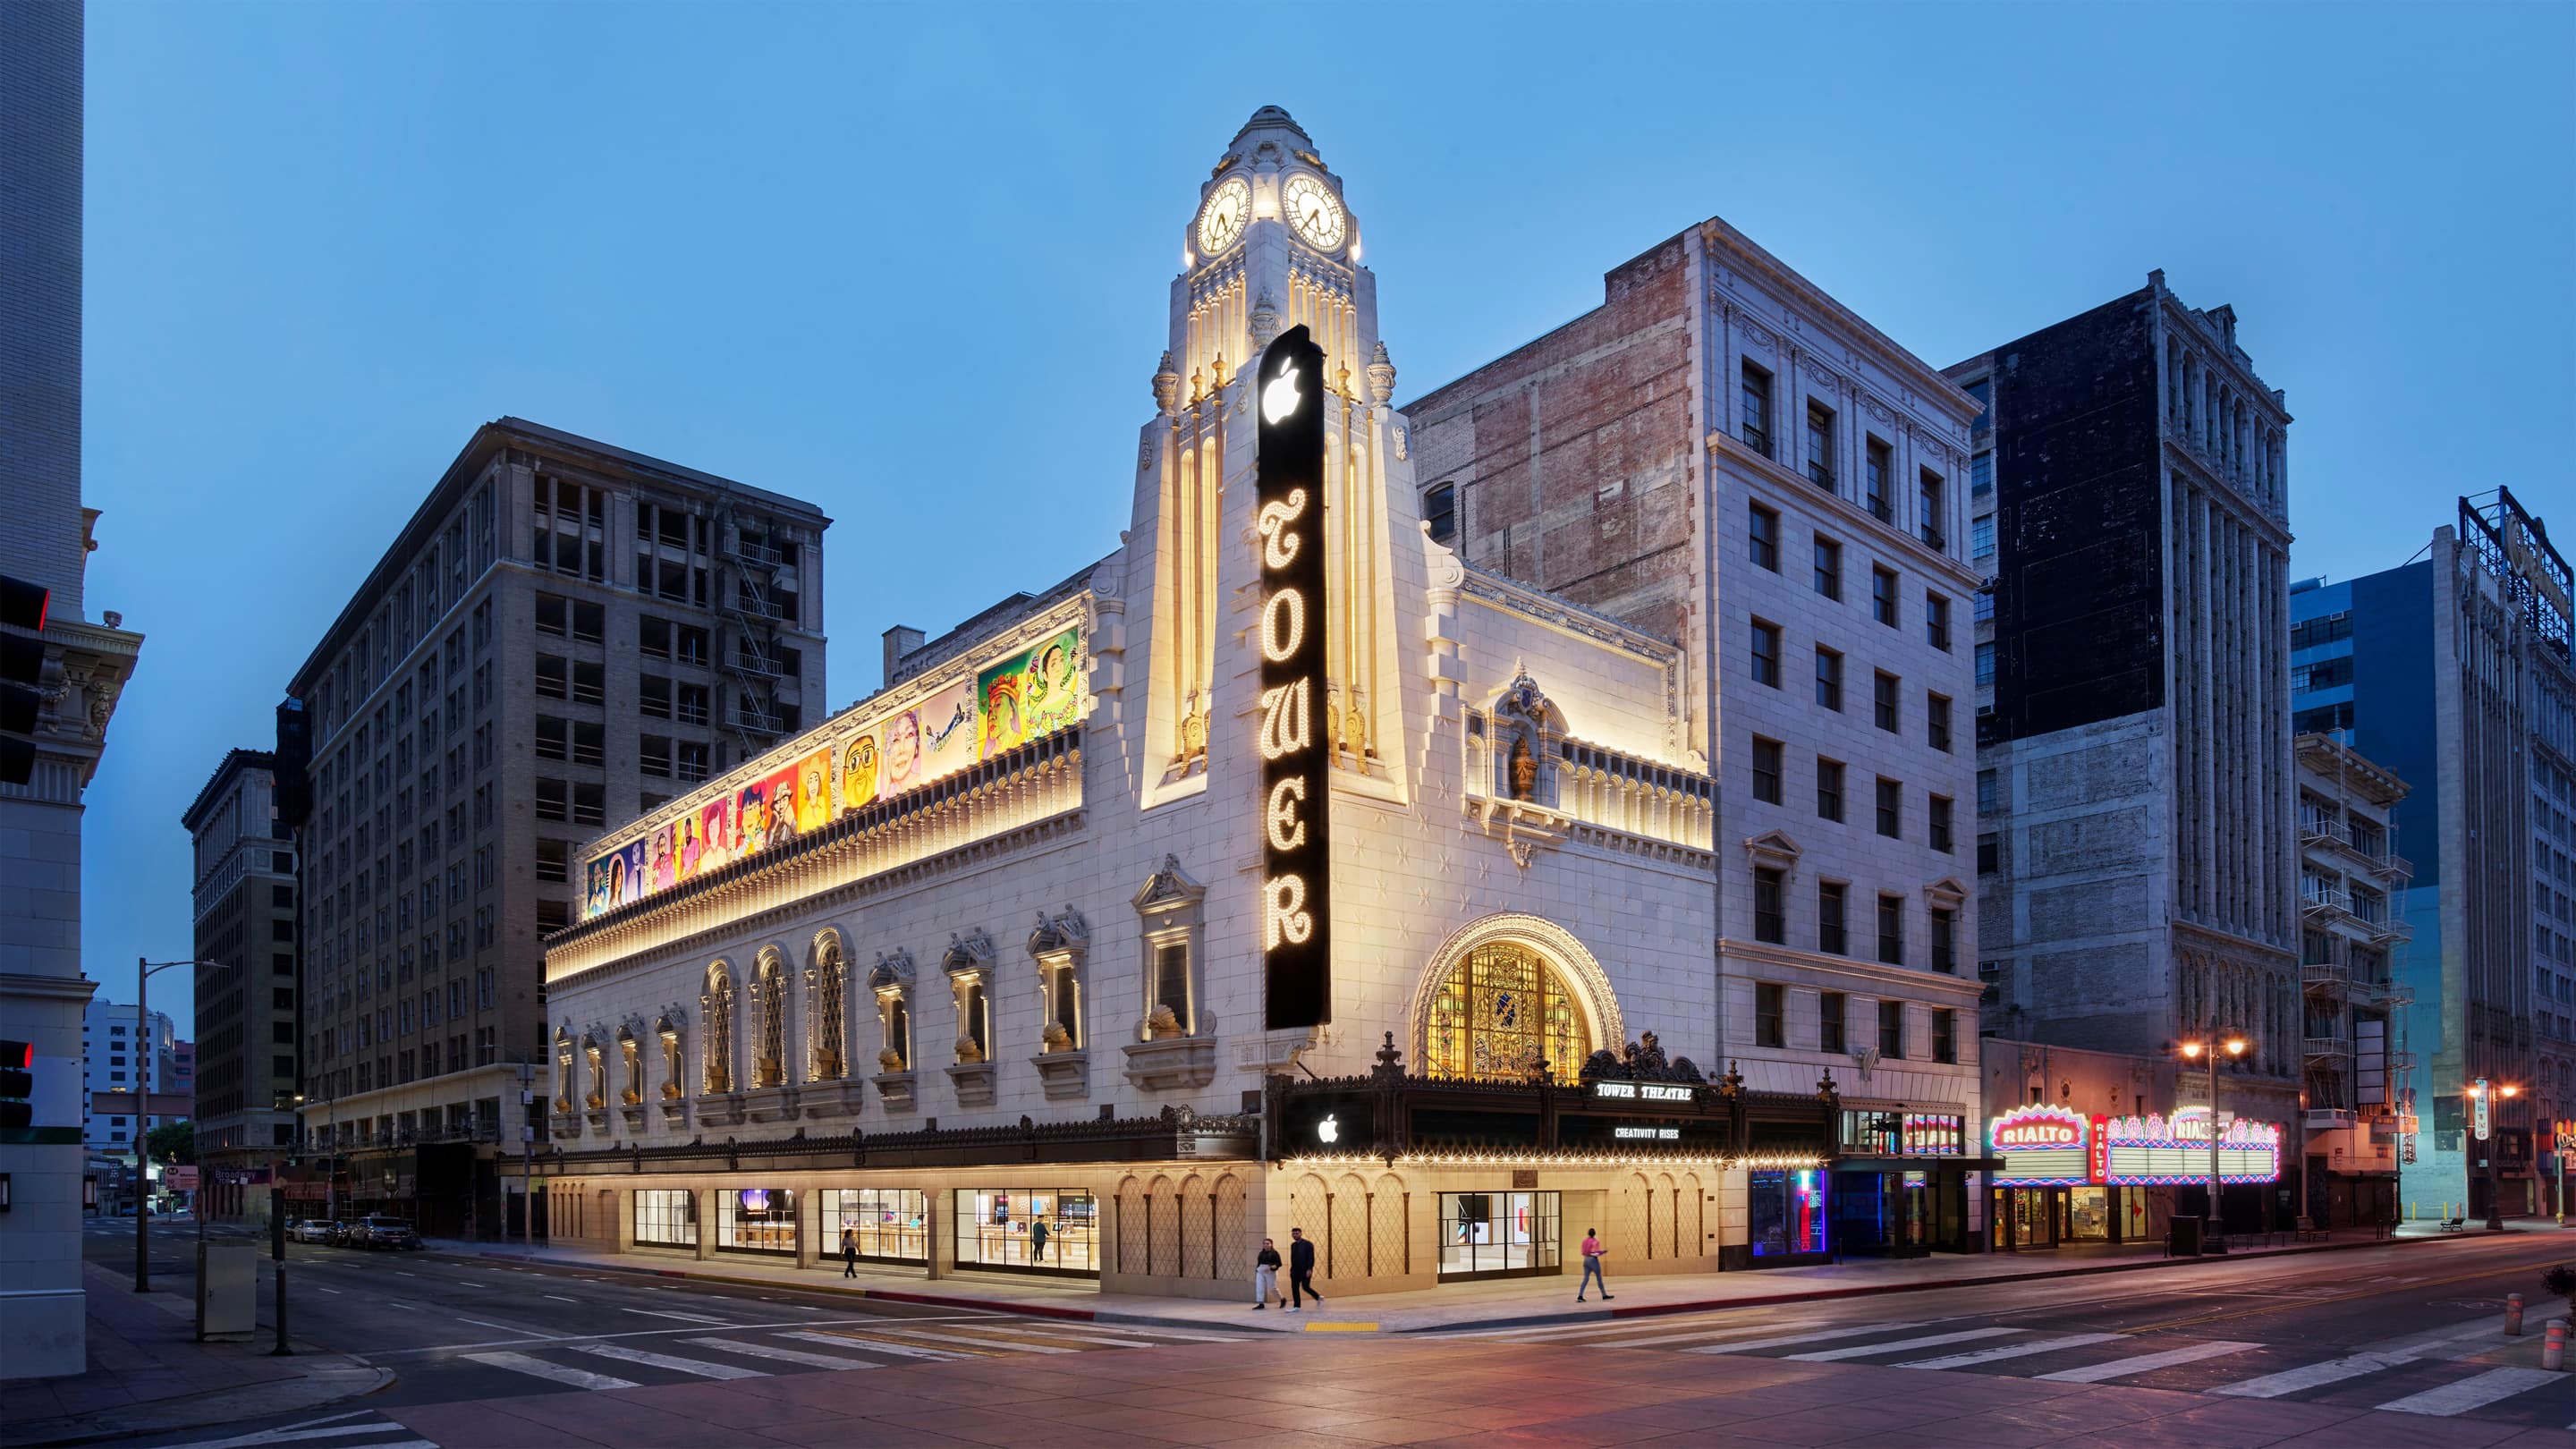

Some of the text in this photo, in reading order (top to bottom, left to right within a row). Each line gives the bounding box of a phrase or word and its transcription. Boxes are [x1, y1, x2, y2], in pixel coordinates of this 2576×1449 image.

[1258, 487, 1311, 953] TOWER
[1597, 1083, 1692, 1101] TOWER THEATRE
[1615, 1128, 1679, 1139] CREATIVITY RISES
[2003, 1126, 2073, 1144] RIALTO
[2095, 1123, 2106, 1178] RIALTO
[215, 1170, 256, 1181] Broadway
